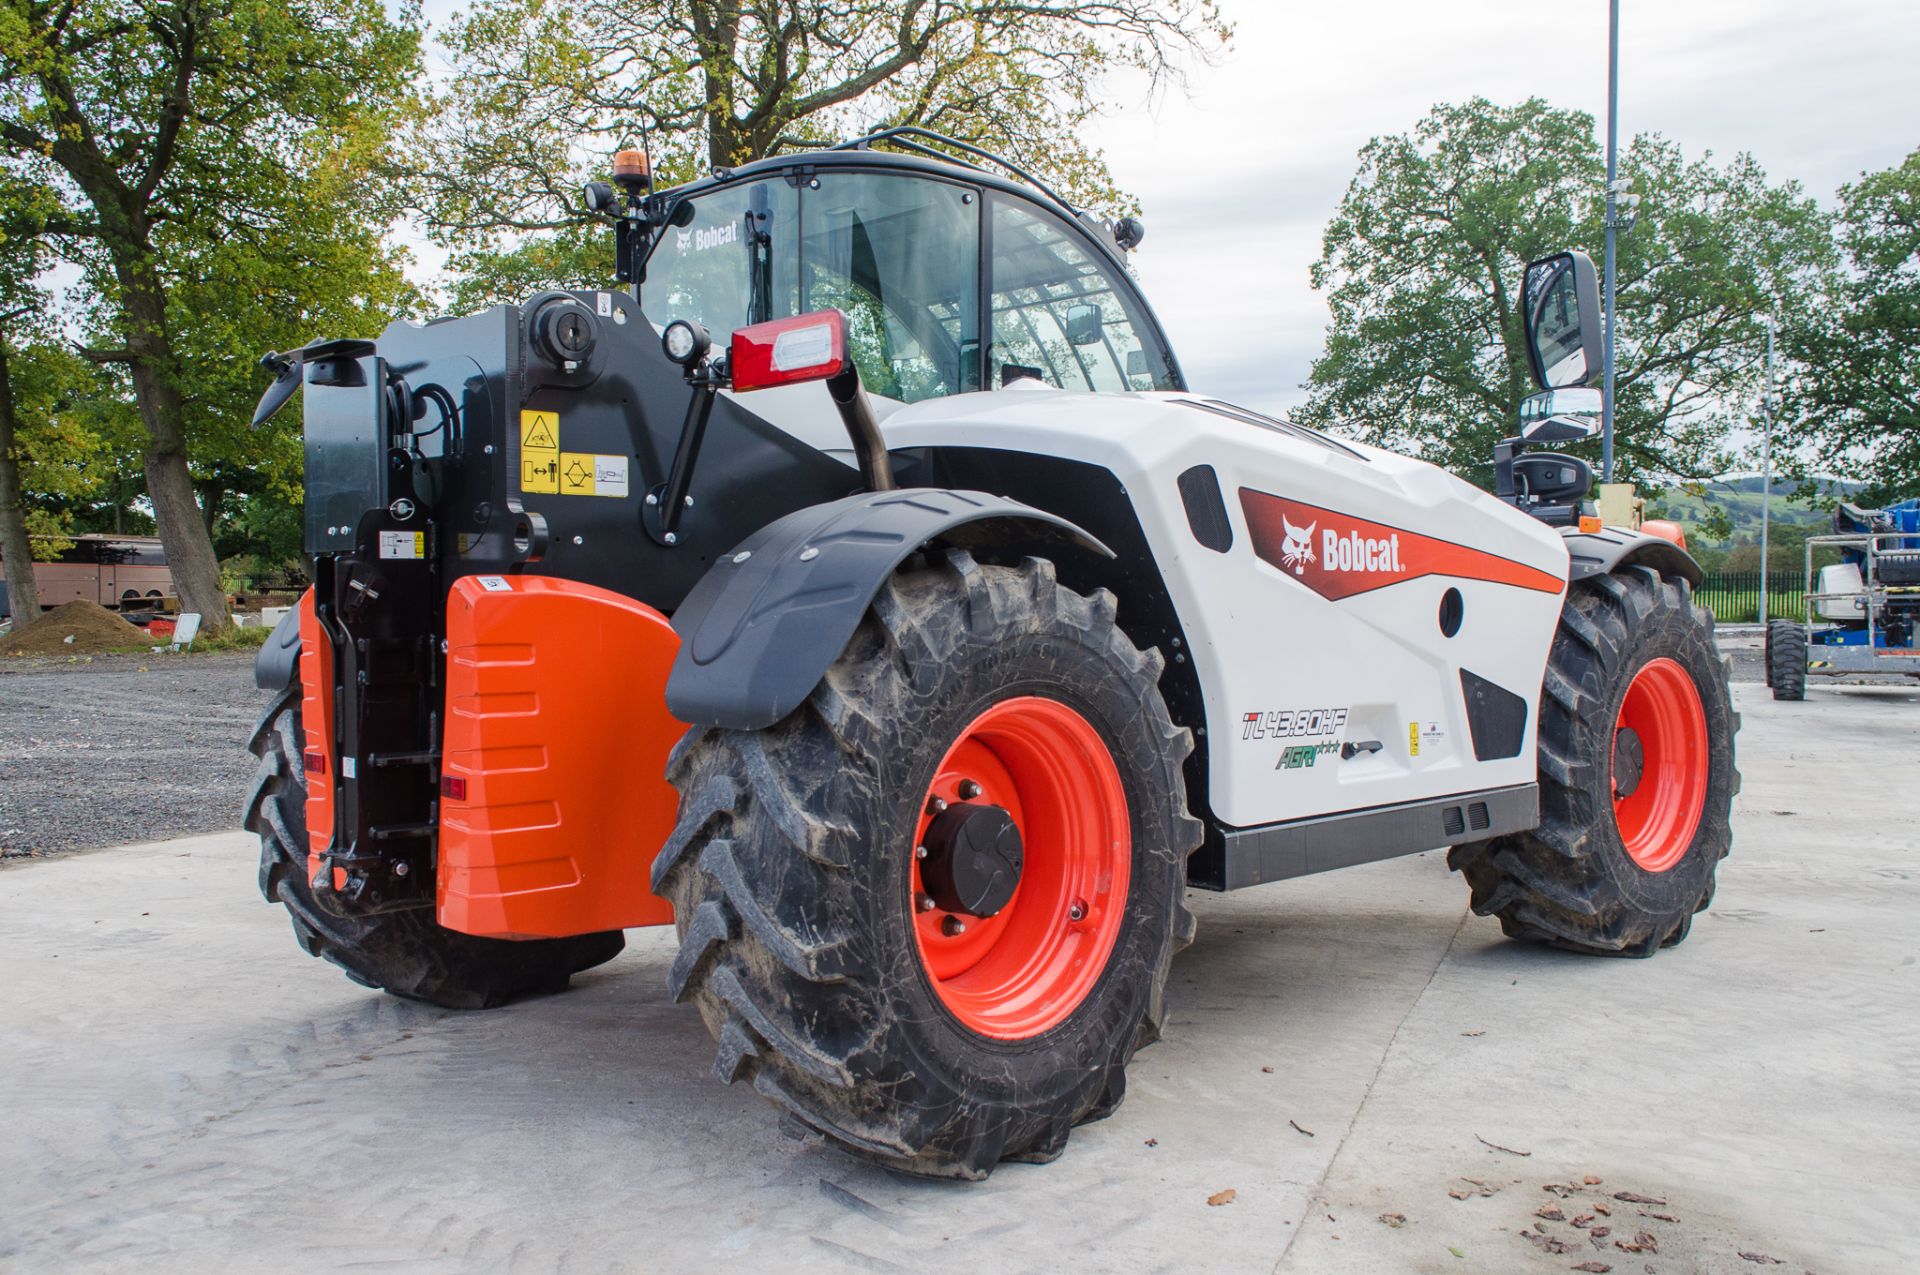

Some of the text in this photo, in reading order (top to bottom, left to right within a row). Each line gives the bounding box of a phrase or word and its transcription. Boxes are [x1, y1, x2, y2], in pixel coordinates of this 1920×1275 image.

[695, 220, 737, 251] Bobcat
[1322, 529, 1400, 573] Bobcat
[1275, 745, 1317, 770] AGRI
